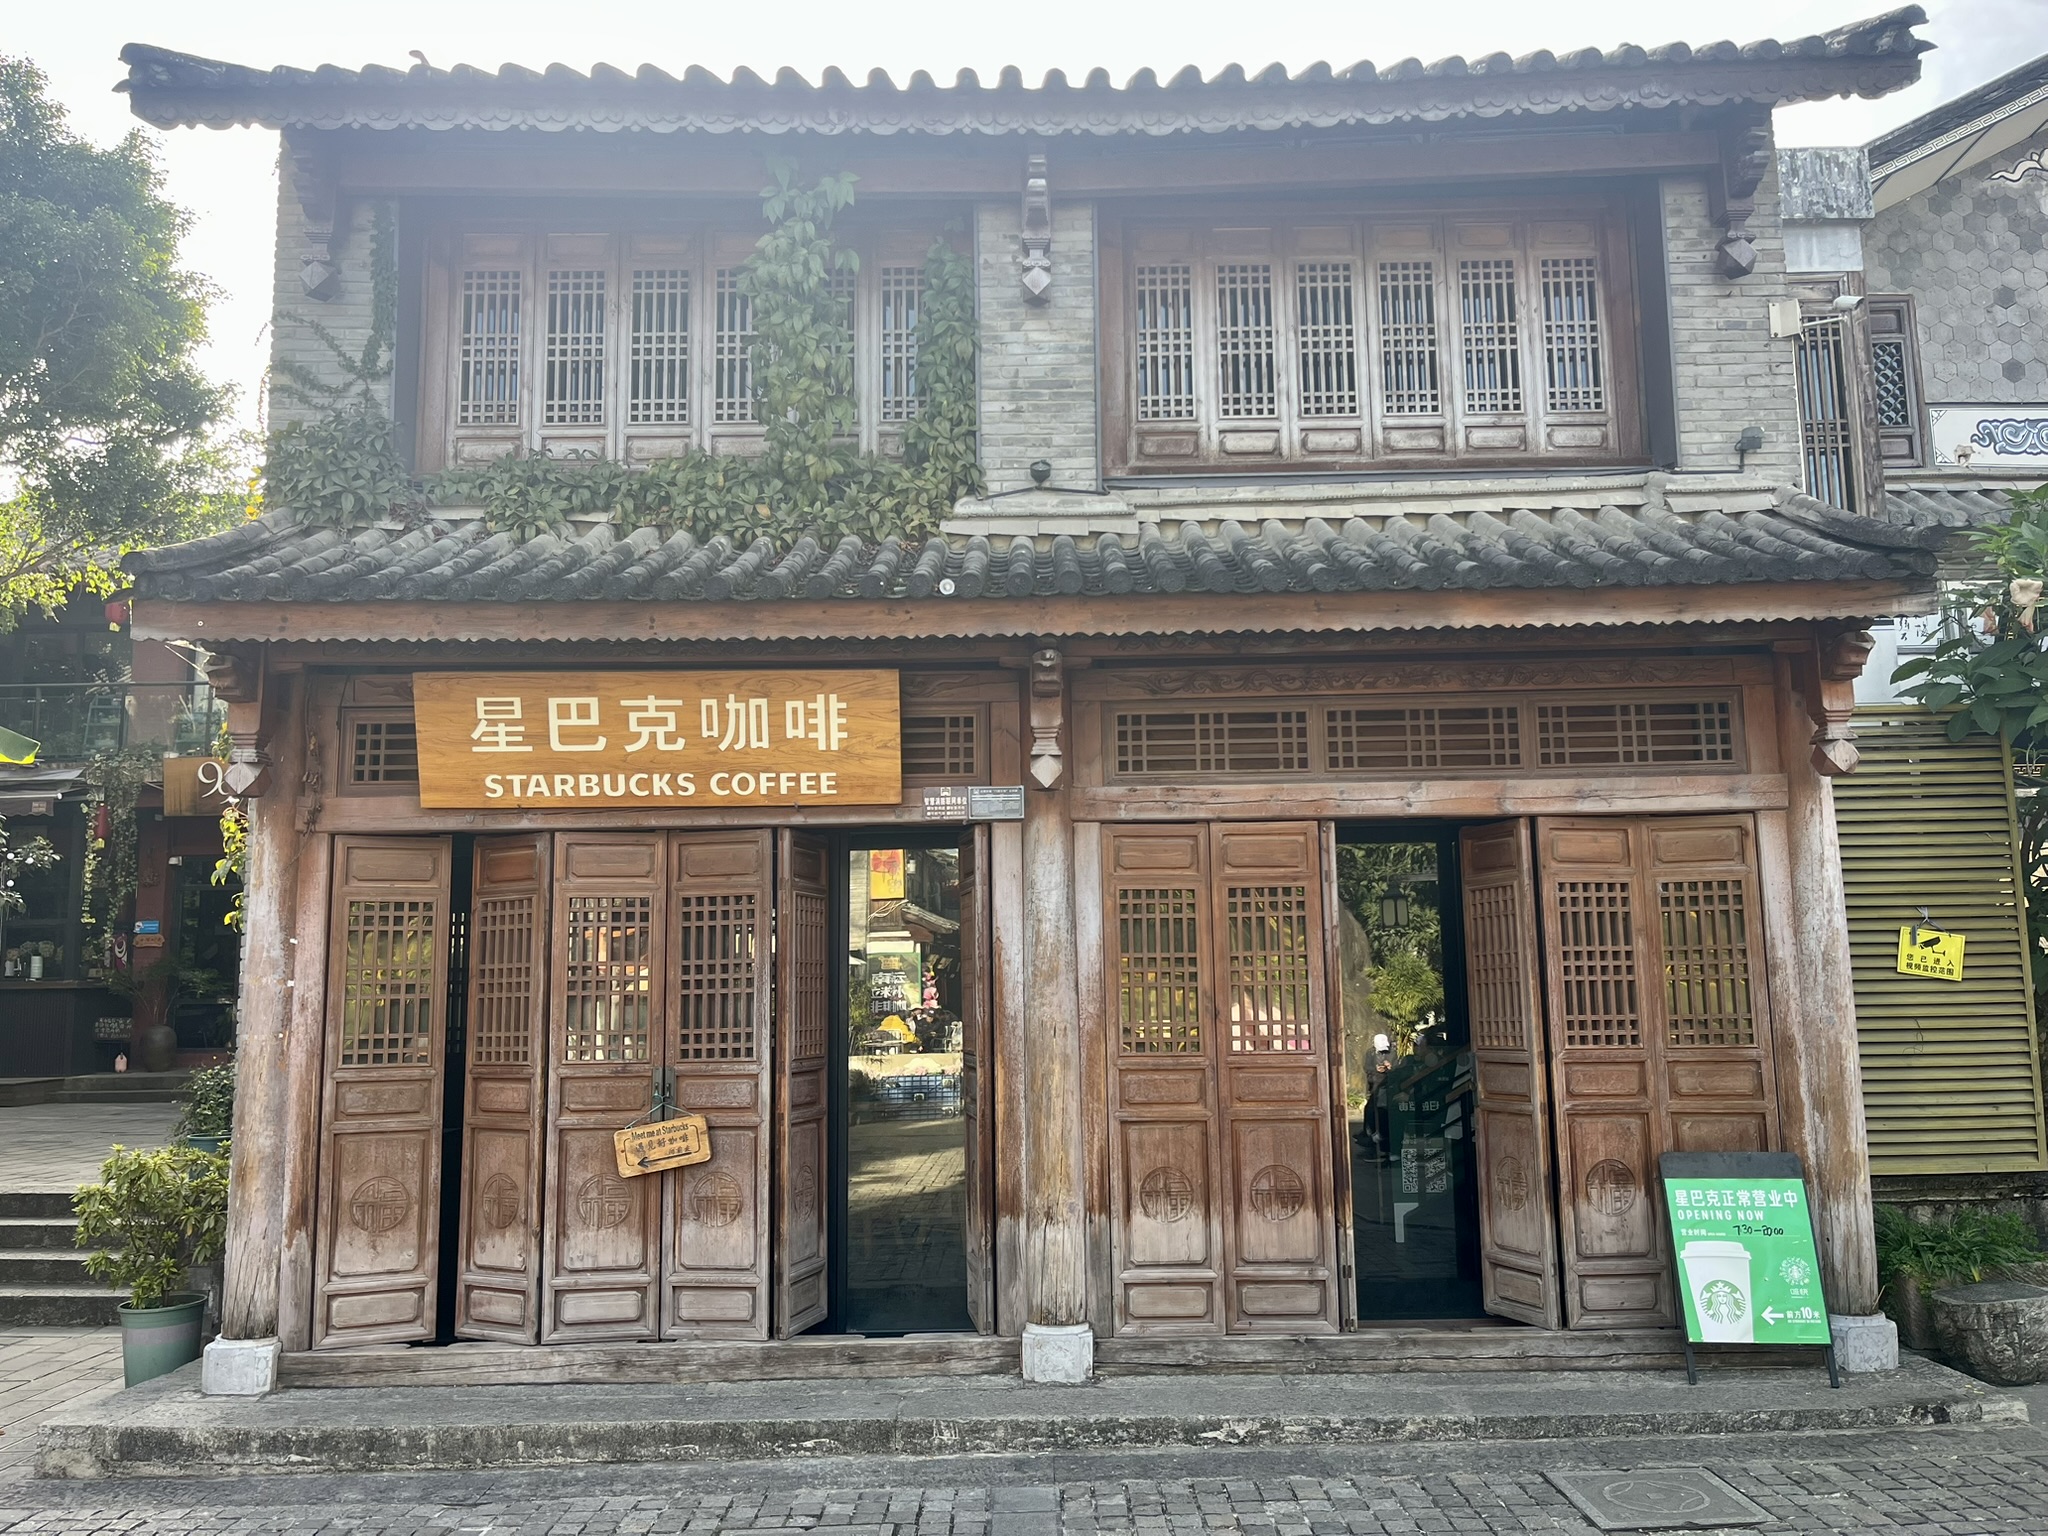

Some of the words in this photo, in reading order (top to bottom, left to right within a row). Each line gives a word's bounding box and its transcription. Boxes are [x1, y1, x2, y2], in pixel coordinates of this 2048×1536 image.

[471, 693, 849, 753] 星巴克咖啡
[484, 772, 697, 798] STARBUCKS
[708, 771, 838, 796] COFFEE
[1906, 953, 1955, 968] 您已进入
[1906, 962, 1955, 976] 视频监控范围
[631, 1131, 646, 1140] Meet
[646, 1130, 655, 1138] me
[656, 1128, 662, 1136] at
[661, 1122, 690, 1135] Starbucks
[1675, 1189, 1798, 1208] 星巴克正常营业中
[1677, 1209, 1732, 1221] OPENING
[1737, 1209, 1764, 1221] NOW
[1681, 1228, 1707, 1237] 营业时间
